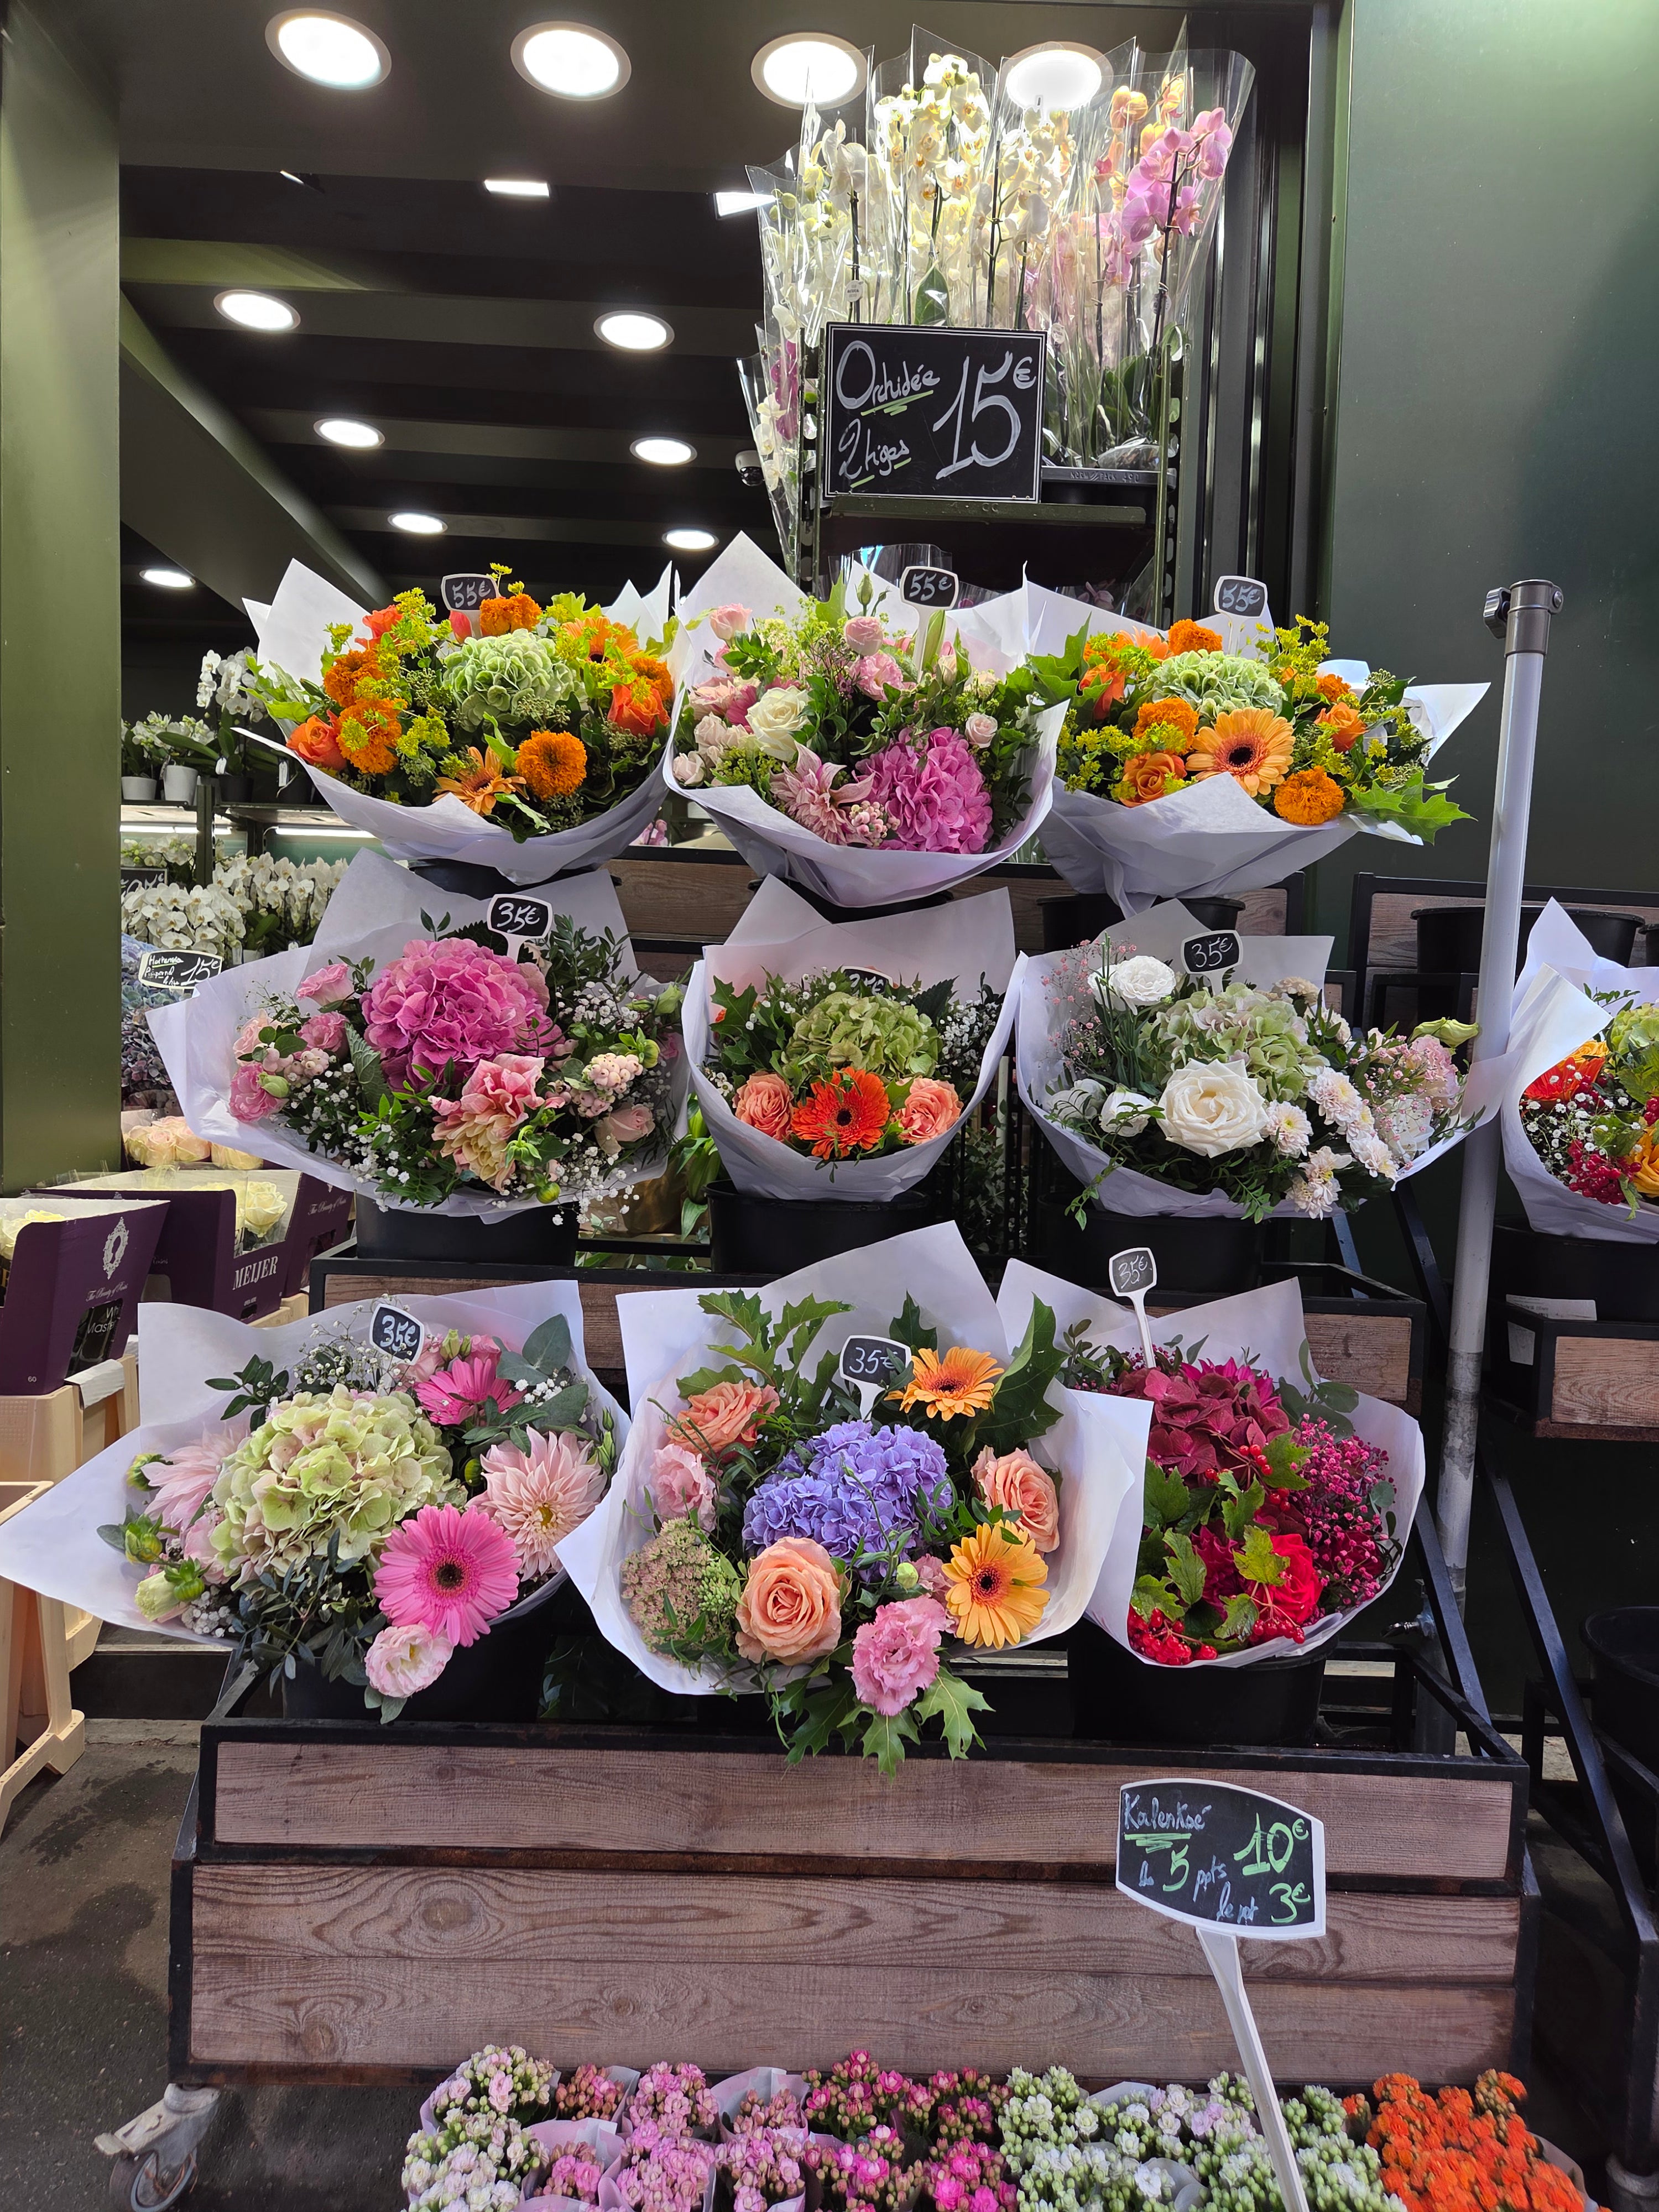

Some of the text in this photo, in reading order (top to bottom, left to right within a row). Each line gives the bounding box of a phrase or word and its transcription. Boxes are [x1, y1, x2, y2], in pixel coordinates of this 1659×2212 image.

[836, 340, 940, 410] Orchidée
[838, 418, 863, 480] 2
[452, 580, 491, 608] 55€
[909, 571, 952, 601] 55€
[1222, 582, 1261, 612] 55€
[497, 902, 540, 933] 35€
[1191, 937, 1233, 968] 35€
[232, 1255, 278, 1291] MEIJER
[1118, 1255, 1148, 1290] 35€
[380, 1315, 418, 1352] 35€
[849, 1347, 899, 1374] 35€
[1233, 1812, 1309, 1876] 10€
[1162, 1844, 1189, 1891] 5
[1269, 1882, 1311, 1923] 3€
